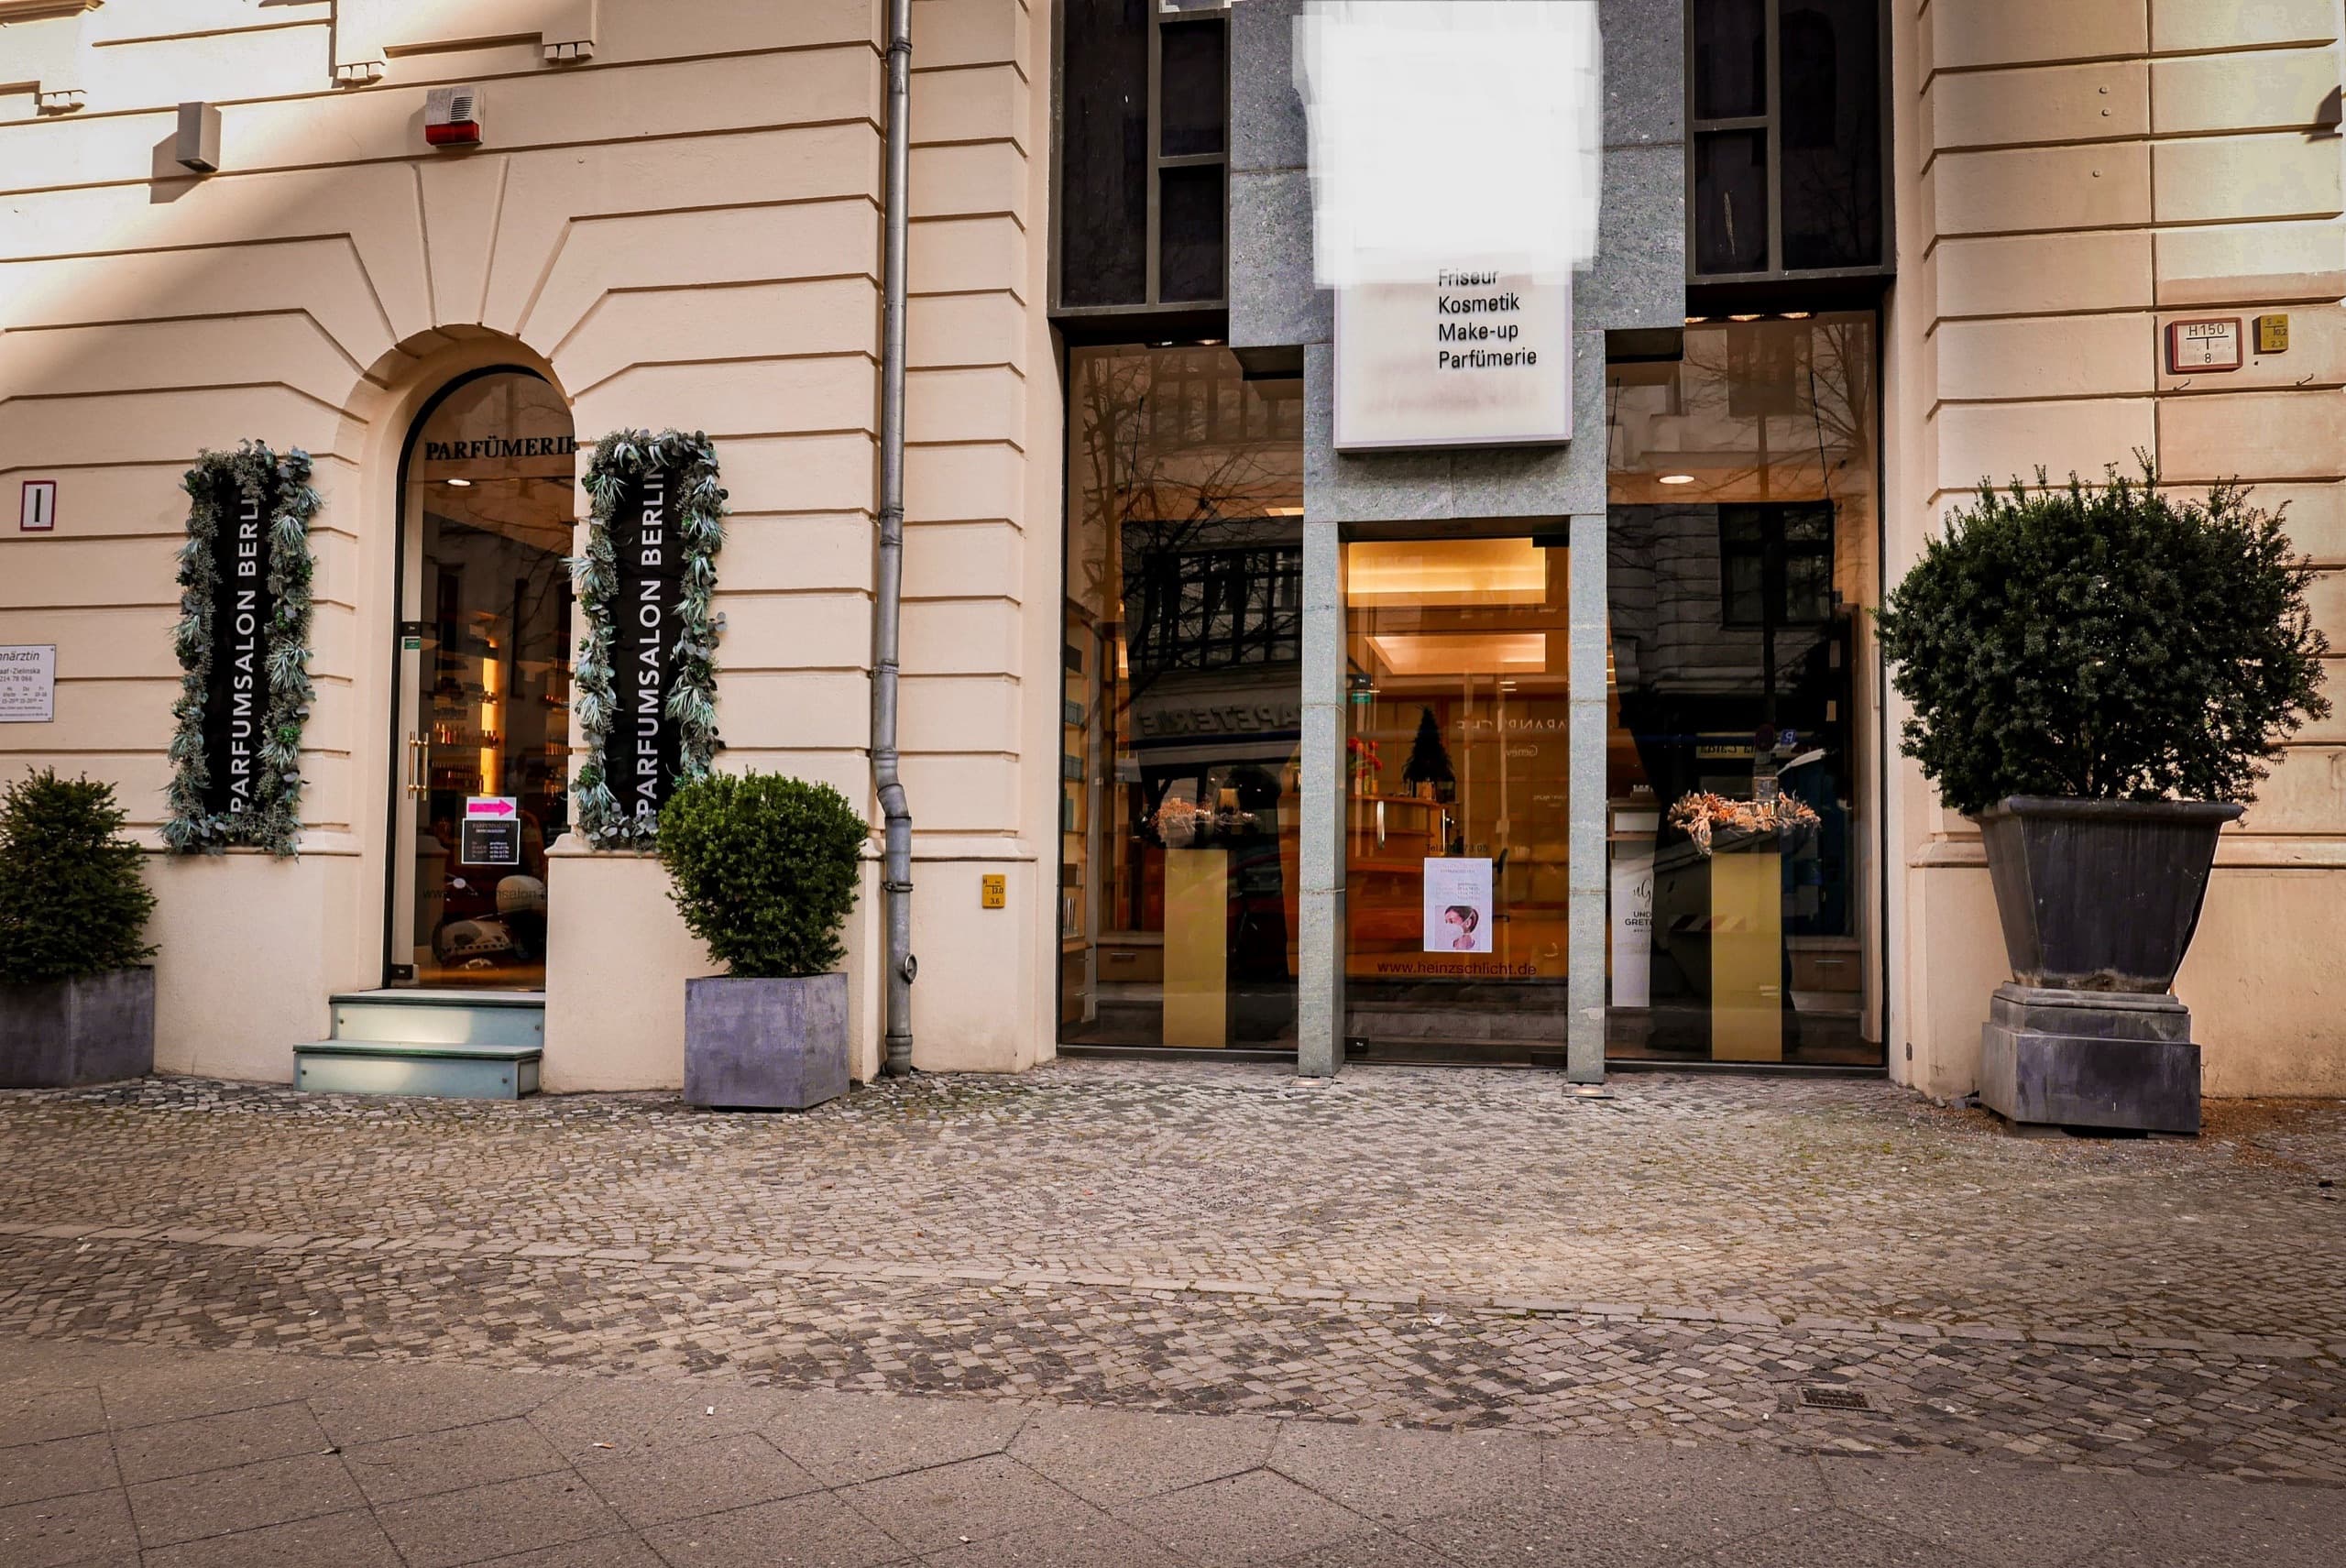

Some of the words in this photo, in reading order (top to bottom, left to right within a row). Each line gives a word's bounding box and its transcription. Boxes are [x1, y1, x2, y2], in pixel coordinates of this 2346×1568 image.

[1438, 268, 1499, 287] Friseur
[1438, 292, 1520, 314] Kosmetik
[1438, 322, 1518, 343] Make-up
[2188, 323, 2225, 336] H150
[1438, 346, 1538, 369] Parfümerie
[2204, 352, 2212, 364] 8
[425, 435, 576, 460] PARFÜMERIE
[238, 488, 258, 576] BERLI
[230, 589, 256, 813] PARFUMSALON
[636, 580, 662, 816] PARFUMSALON
[1377, 962, 1537, 976] www.heinzschlicht.de
